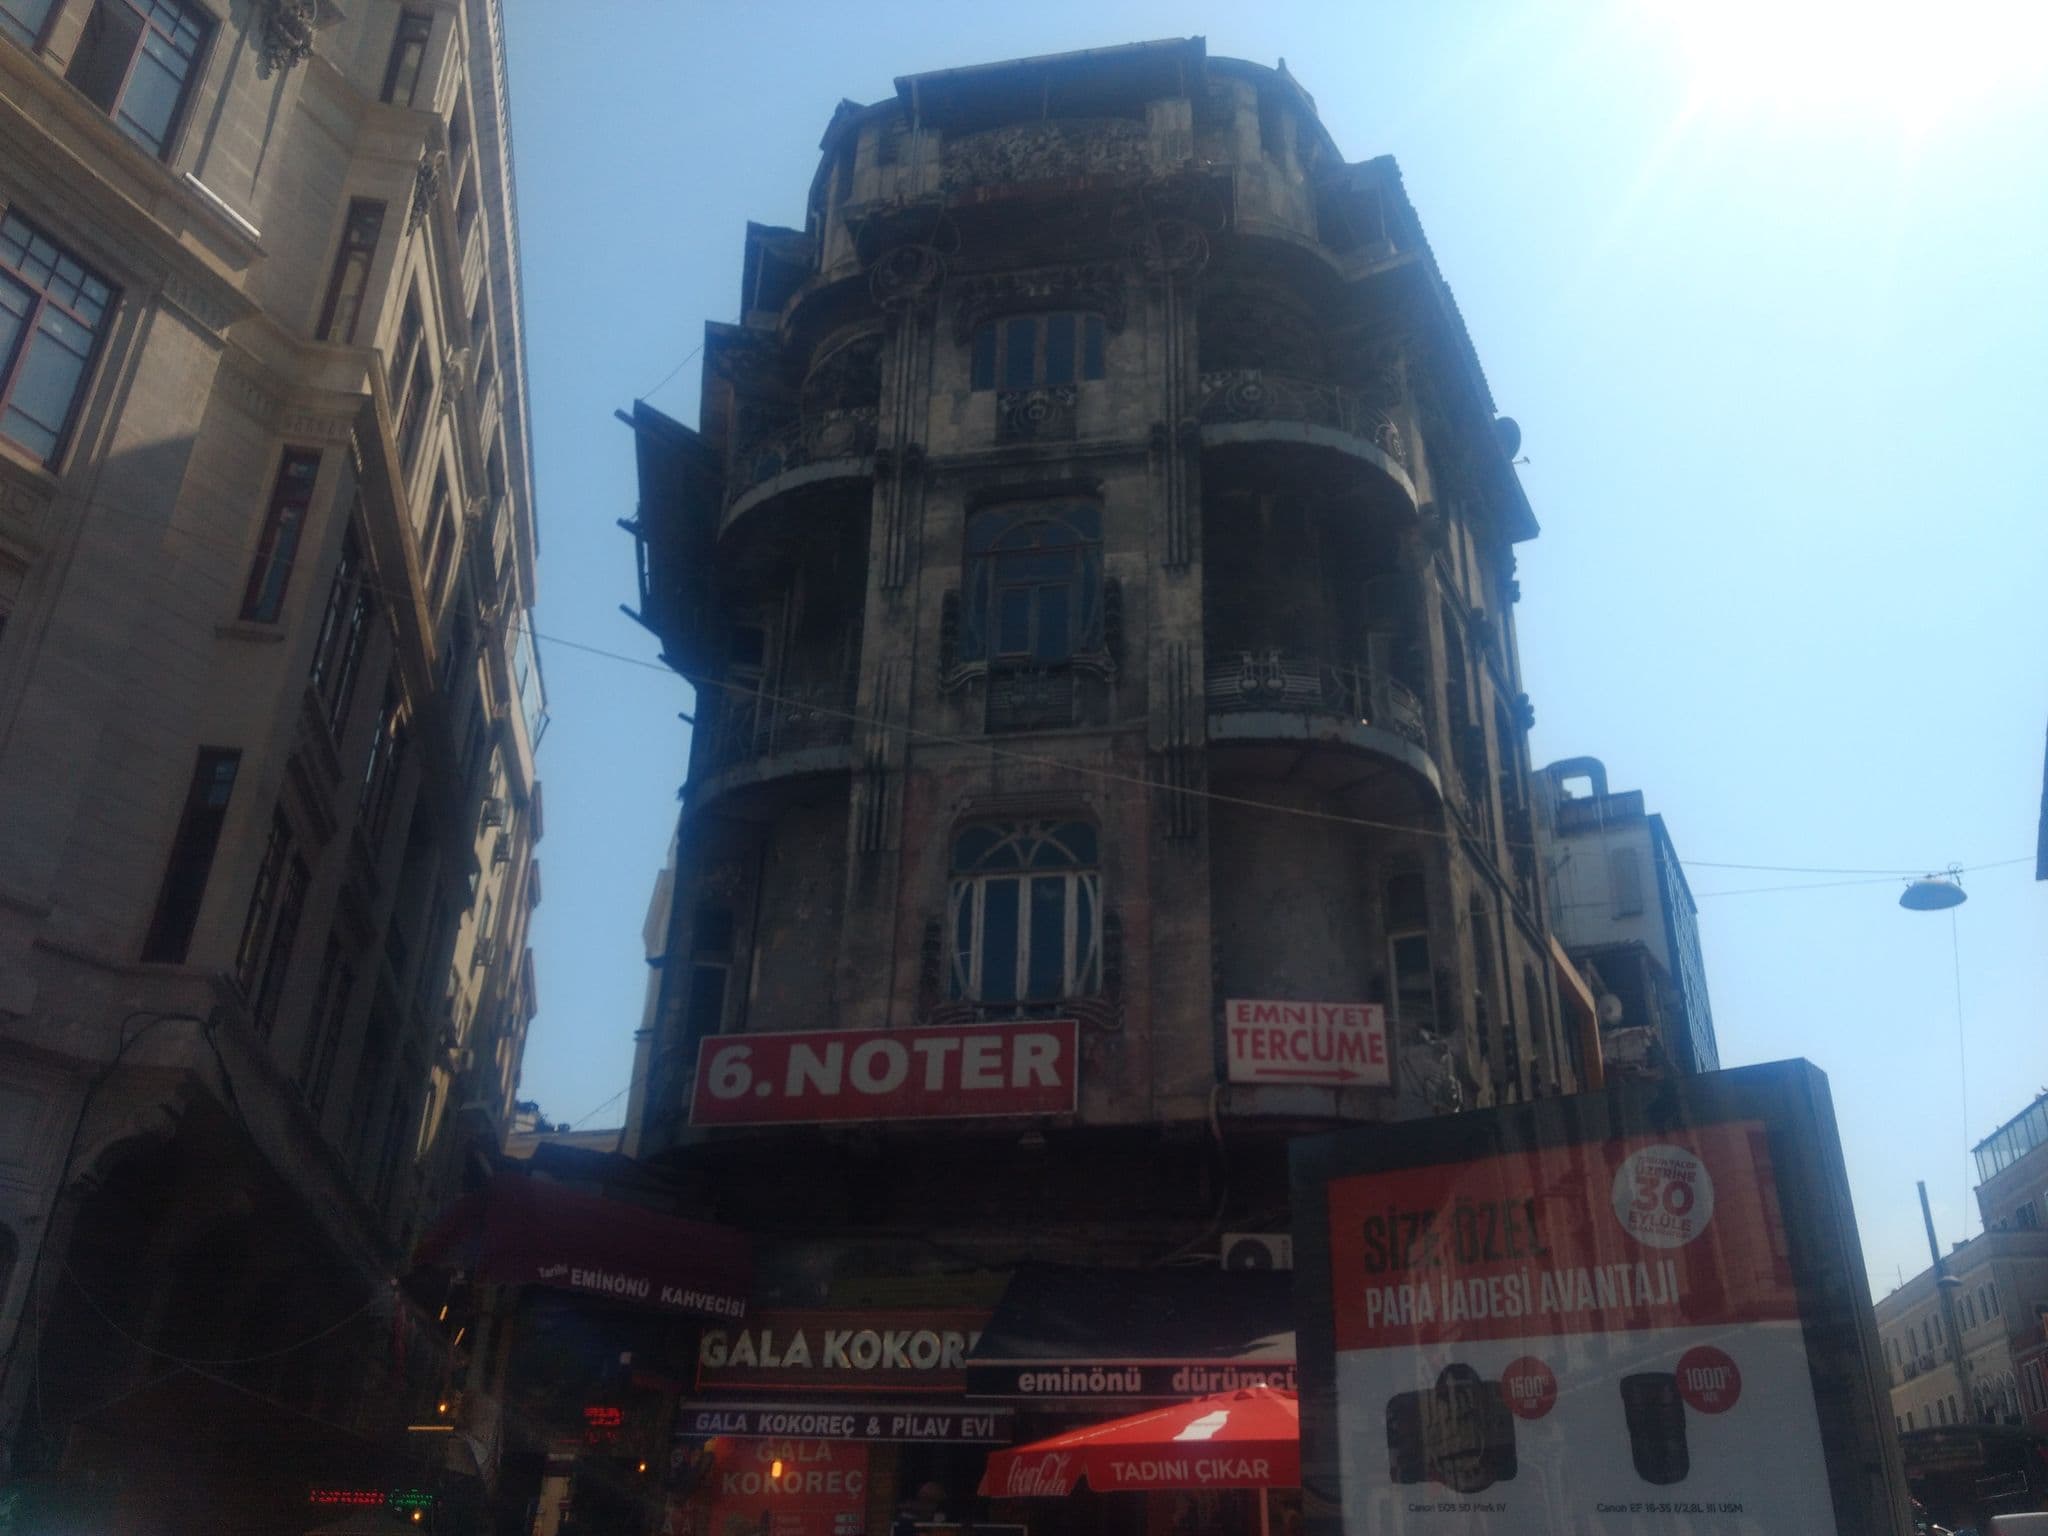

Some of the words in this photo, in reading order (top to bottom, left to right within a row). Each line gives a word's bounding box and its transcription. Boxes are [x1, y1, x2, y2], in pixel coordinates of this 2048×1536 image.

[707, 1044, 775, 1099] 6.
[784, 1033, 1063, 1097] NOTER
[1630, 1175, 1694, 1217] 30
[1363, 1204, 1441, 1274] SİZE
[1453, 1195, 1548, 1266] ÖZEL
[570, 1267, 652, 1298] EMİNÖNÜ
[660, 1284, 747, 1318] KAHVECİSİ
[1365, 1282, 1435, 1329] PARA
[1441, 1265, 1532, 1323] İADESİ
[1539, 1258, 1680, 1315] AVANTAJI
[701, 1328, 815, 1369] GALA
[1018, 1367, 1142, 1393] eminönü
[696, 1412, 747, 1432] GALA
[757, 1415, 855, 1439] KOKOREÇ
[866, 1415, 880, 1435] &
[892, 1413, 950, 1436] PİLAV
[961, 1415, 995, 1436] EVİ
[756, 1440, 832, 1463] GALA
[721, 1470, 863, 1500] KOKOREÇ
[1111, 1461, 1188, 1480] TADINI
[1195, 1459, 1269, 1483] ÇIKAR
[1597, 1503, 1627, 1513] Canon
